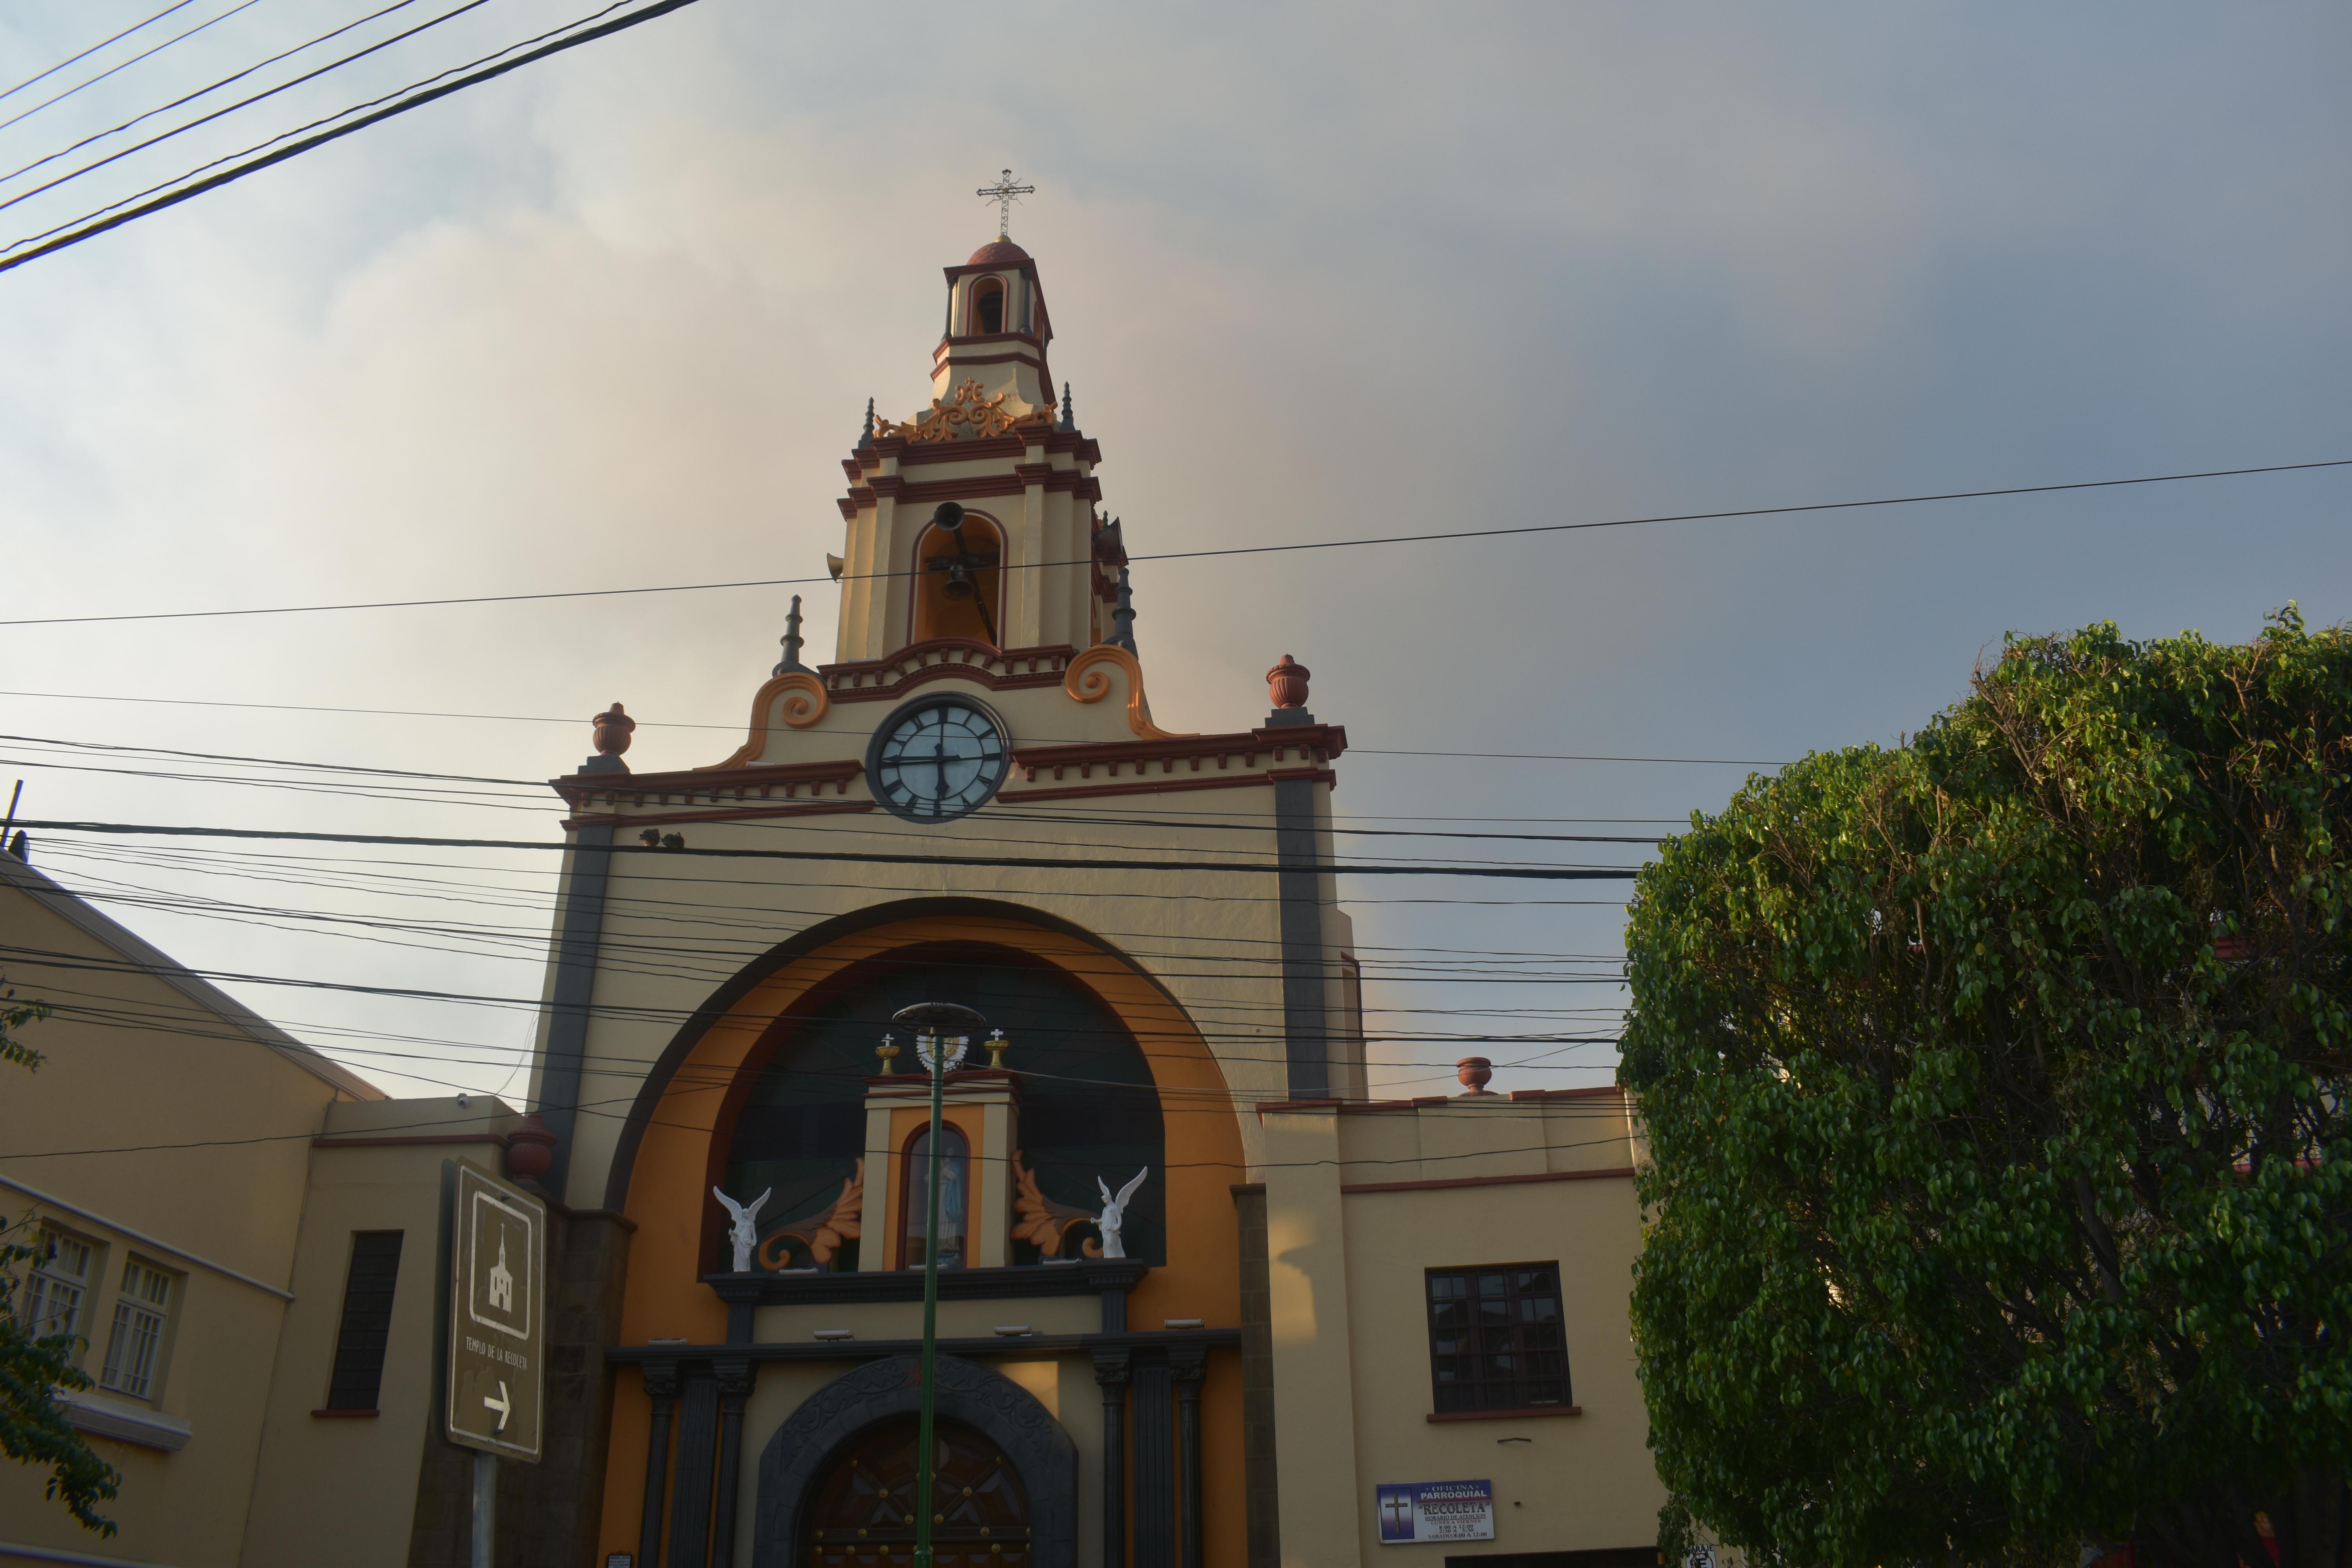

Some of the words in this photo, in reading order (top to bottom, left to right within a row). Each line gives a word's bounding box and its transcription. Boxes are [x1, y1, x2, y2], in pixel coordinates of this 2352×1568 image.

[466, 1336, 486, 1355] TEMPLO
[488, 1344, 495, 1358] DE
[497, 1347, 503, 1361] LA
[505, 1350, 527, 1370] RECOLETA
[1421, 1490, 1486, 1499] PARROQUIAL
